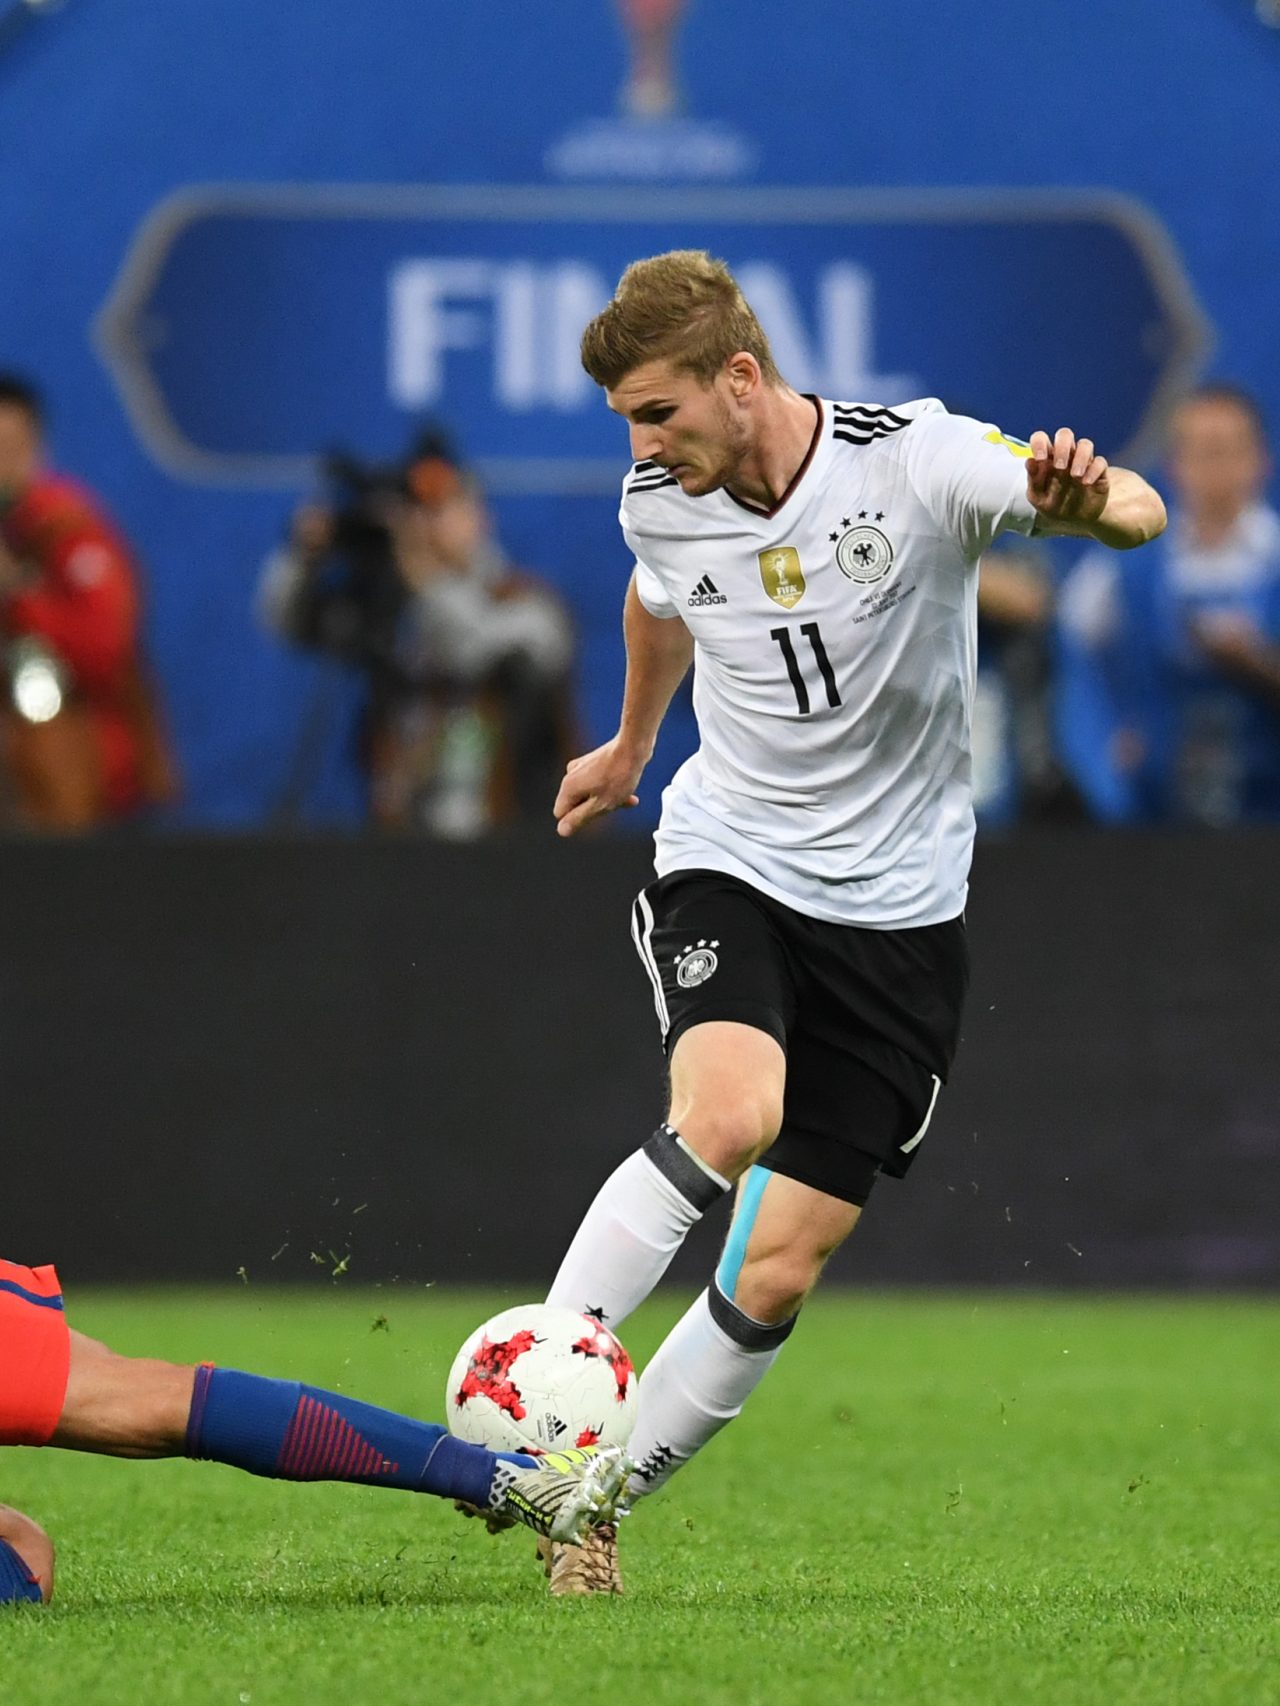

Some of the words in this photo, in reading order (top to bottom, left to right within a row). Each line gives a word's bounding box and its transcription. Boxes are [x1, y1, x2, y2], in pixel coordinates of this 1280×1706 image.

[687, 594, 728, 607] adidas
[769, 621, 842, 715] 11
[545, 1412, 554, 1442] adidas
[507, 1488, 543, 1521] EMEZIZ
